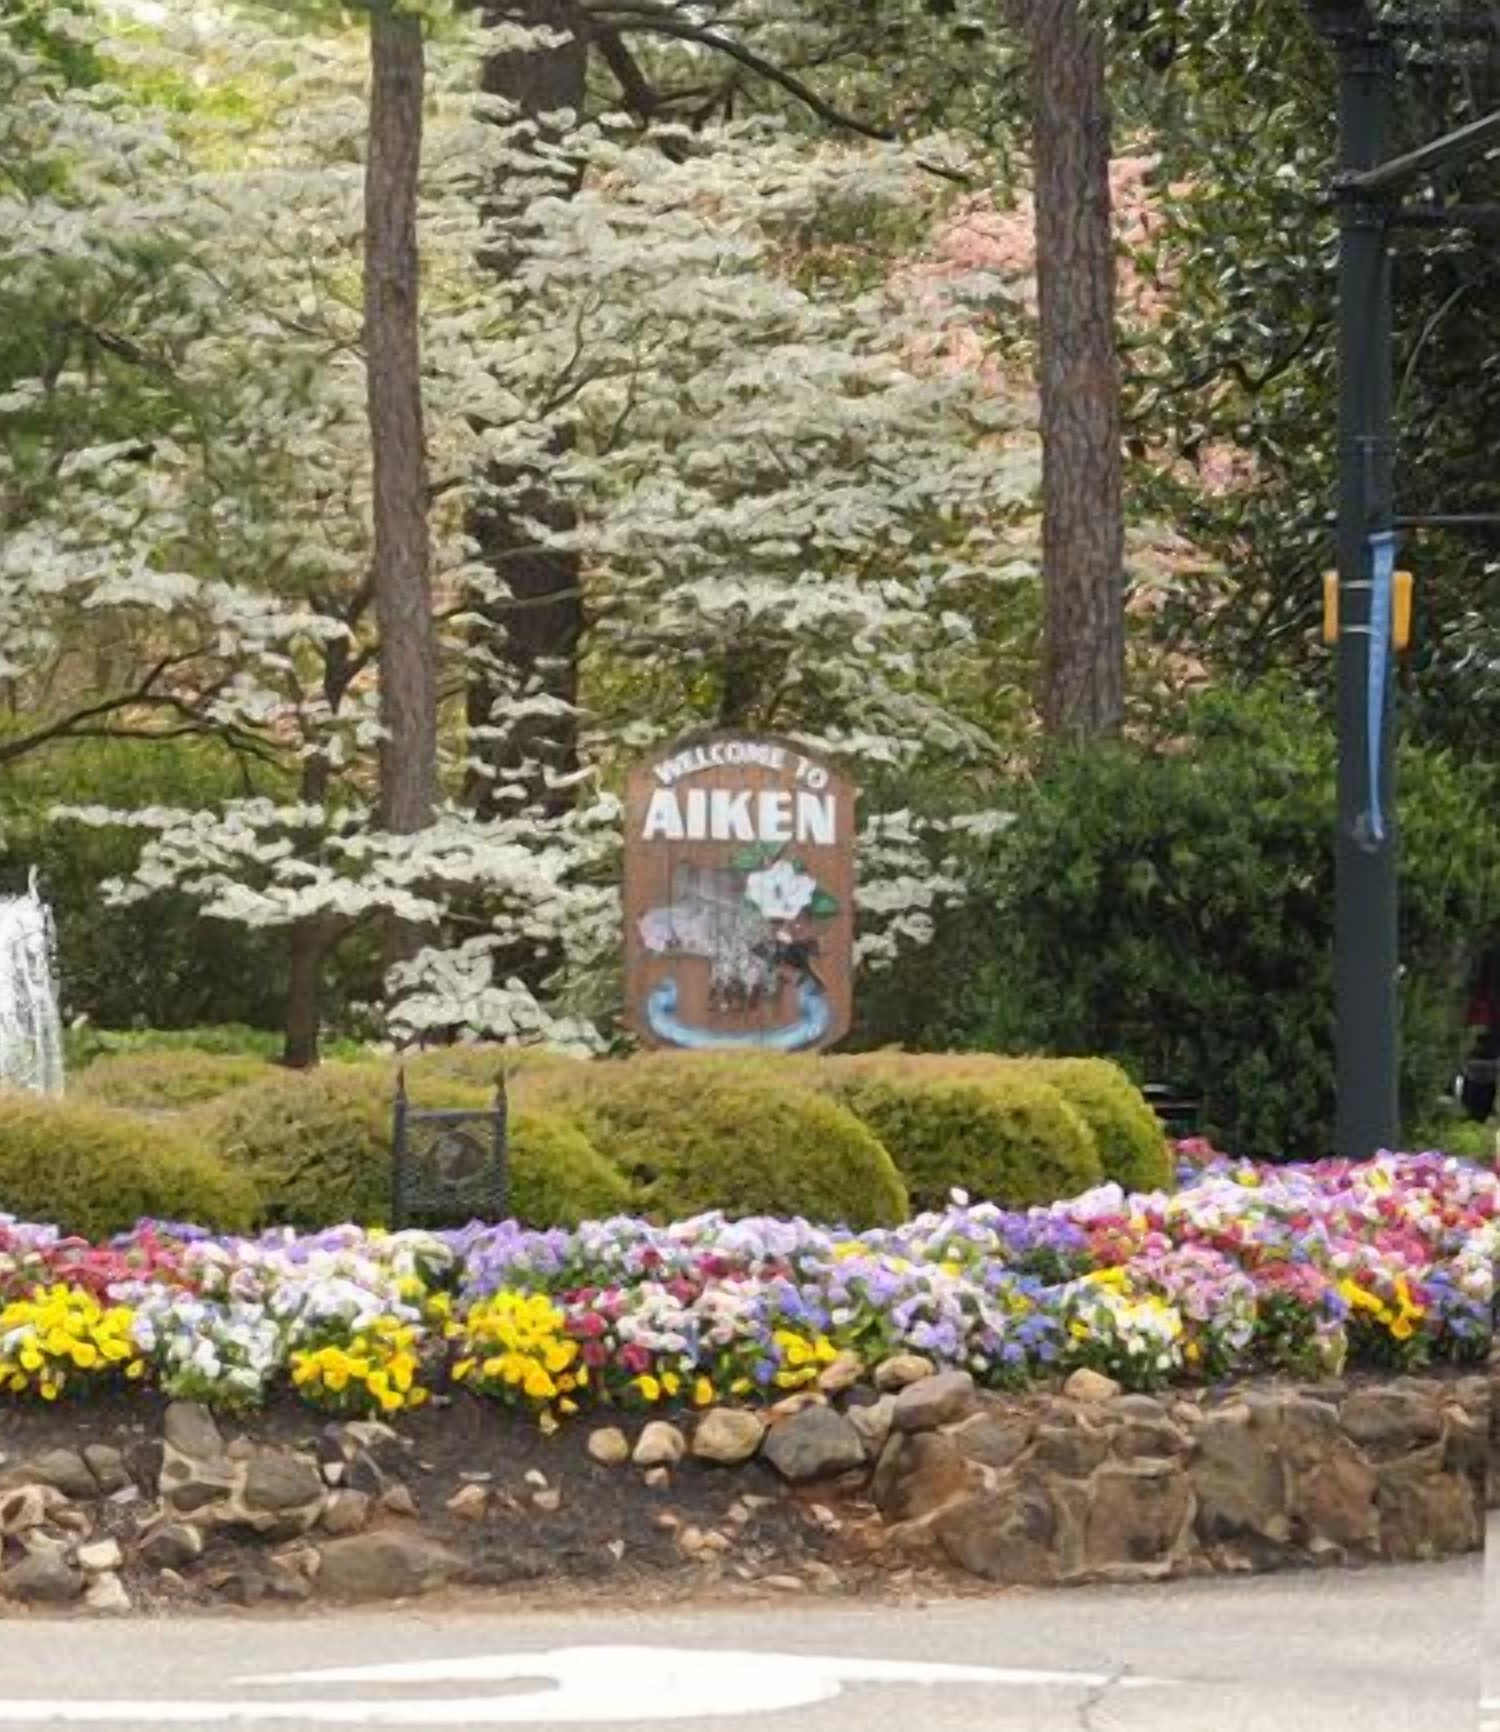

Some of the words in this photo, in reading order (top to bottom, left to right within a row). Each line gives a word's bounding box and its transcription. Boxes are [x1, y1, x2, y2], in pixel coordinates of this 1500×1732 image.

[653, 741, 788, 784] WELCOME
[796, 755, 829, 789] TO
[642, 788, 837, 845] AIKEN
